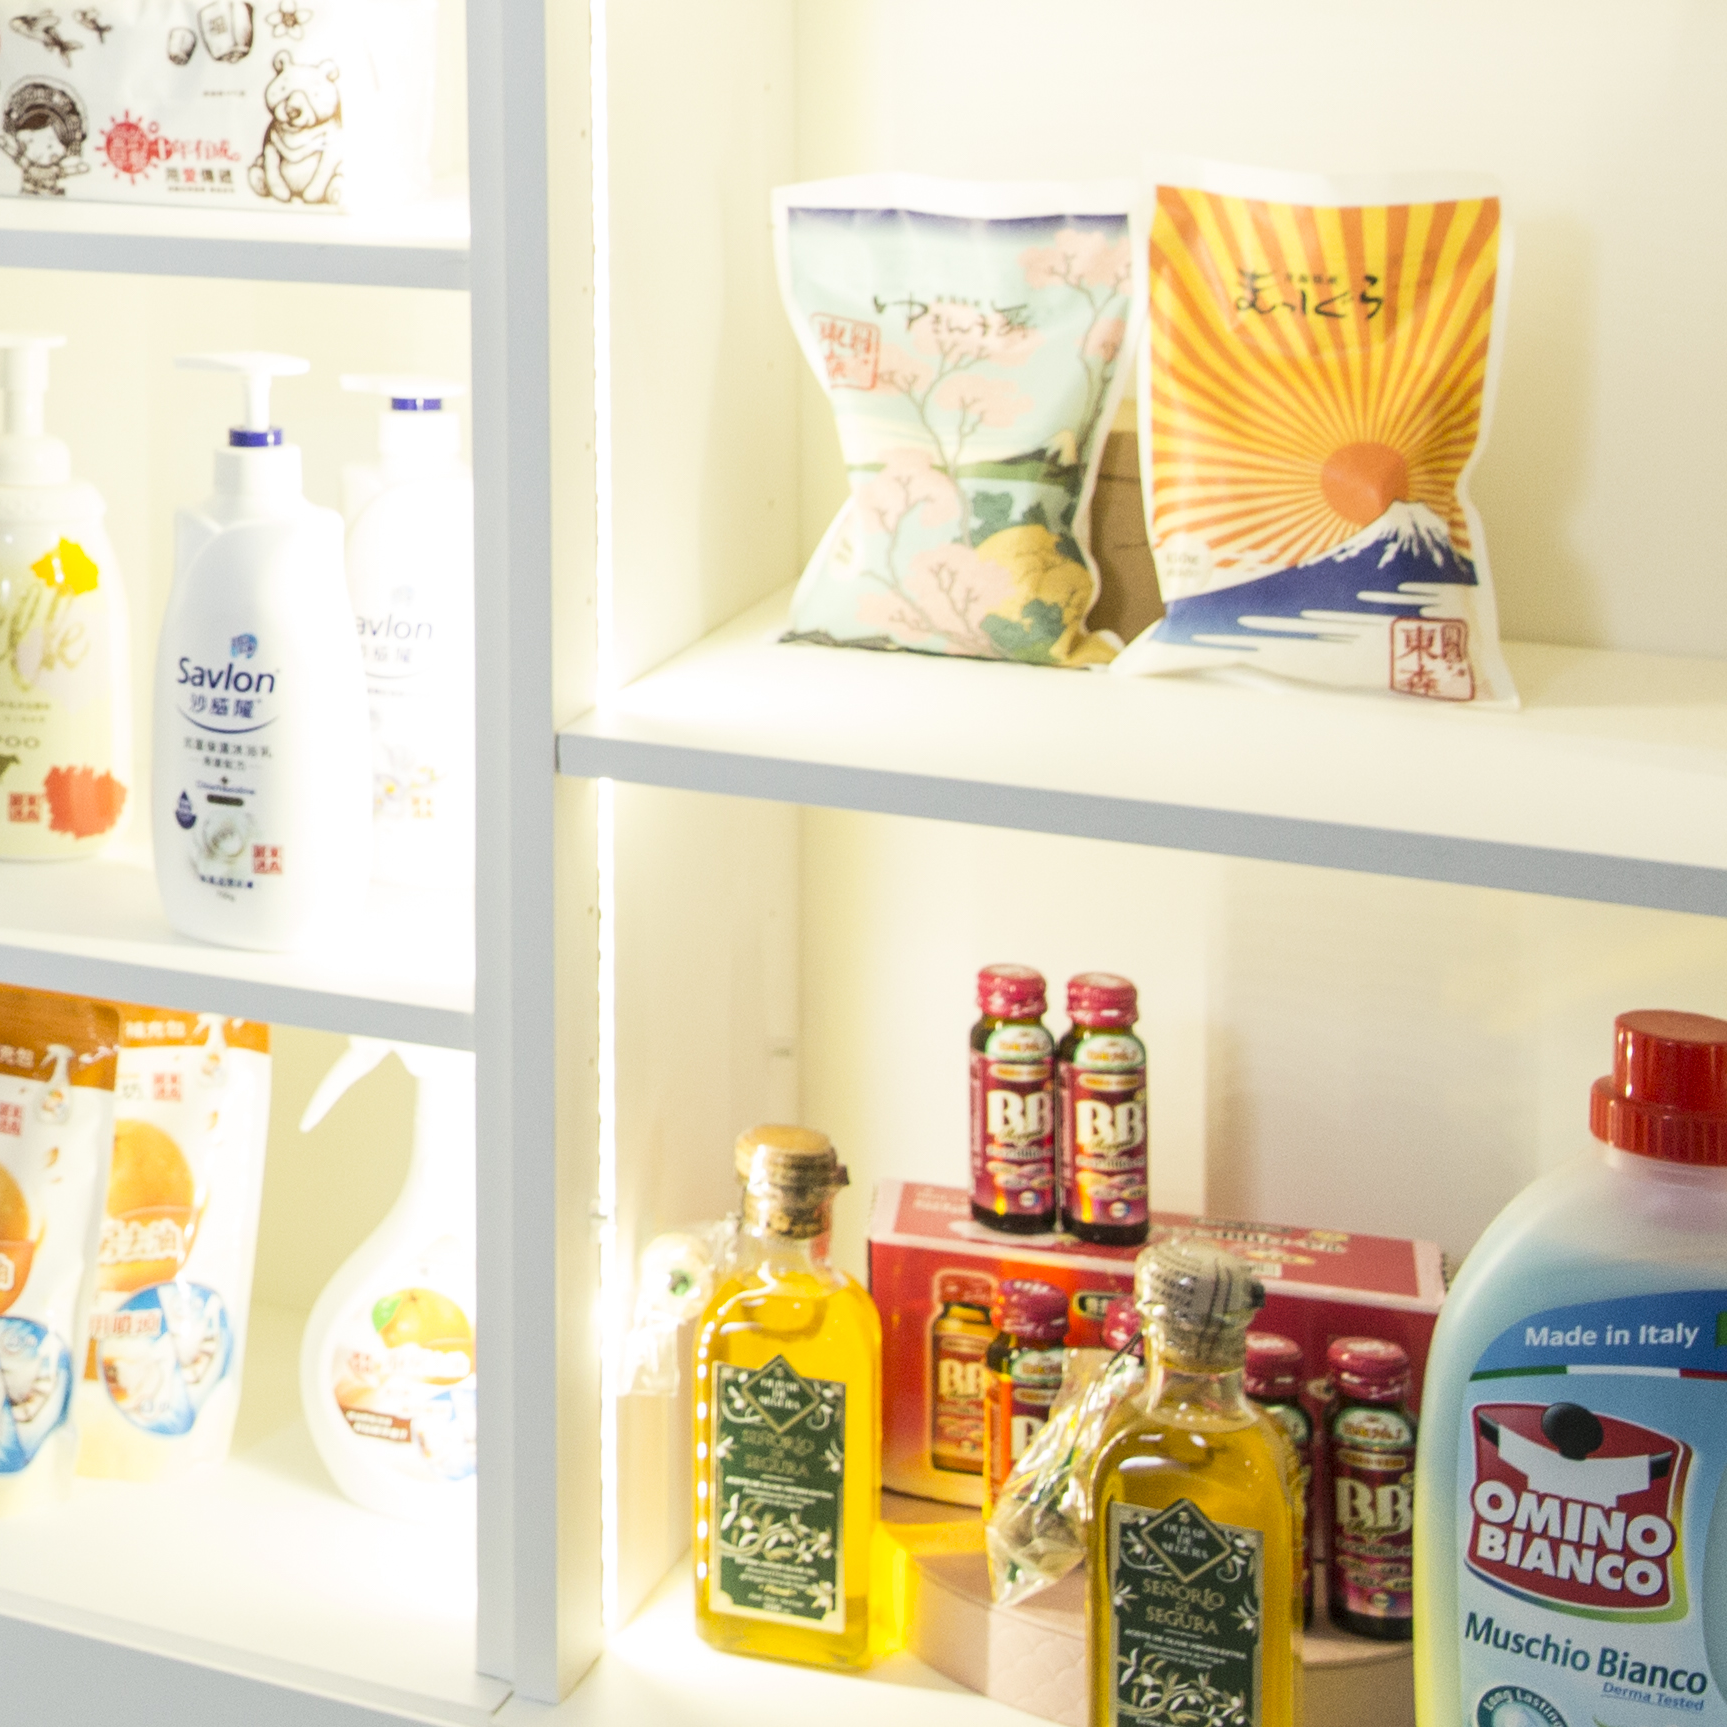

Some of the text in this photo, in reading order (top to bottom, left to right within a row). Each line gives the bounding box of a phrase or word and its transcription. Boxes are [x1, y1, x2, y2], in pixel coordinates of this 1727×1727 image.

[356, 613, 433, 640] avlon
[177, 656, 276, 694] Savlon
[1525, 1322, 1699, 1352] Made in Italy
[1473, 1479, 1676, 1559] OMINO
[1477, 1525, 1664, 1597] BIANCO
[1146, 1605, 1219, 1635] SEGURA
[1465, 1611, 1708, 1695] Muschio Bianco
[1482, 1688, 1514, 1711] Long
[1602, 1681, 1705, 1712] Derma Tested
